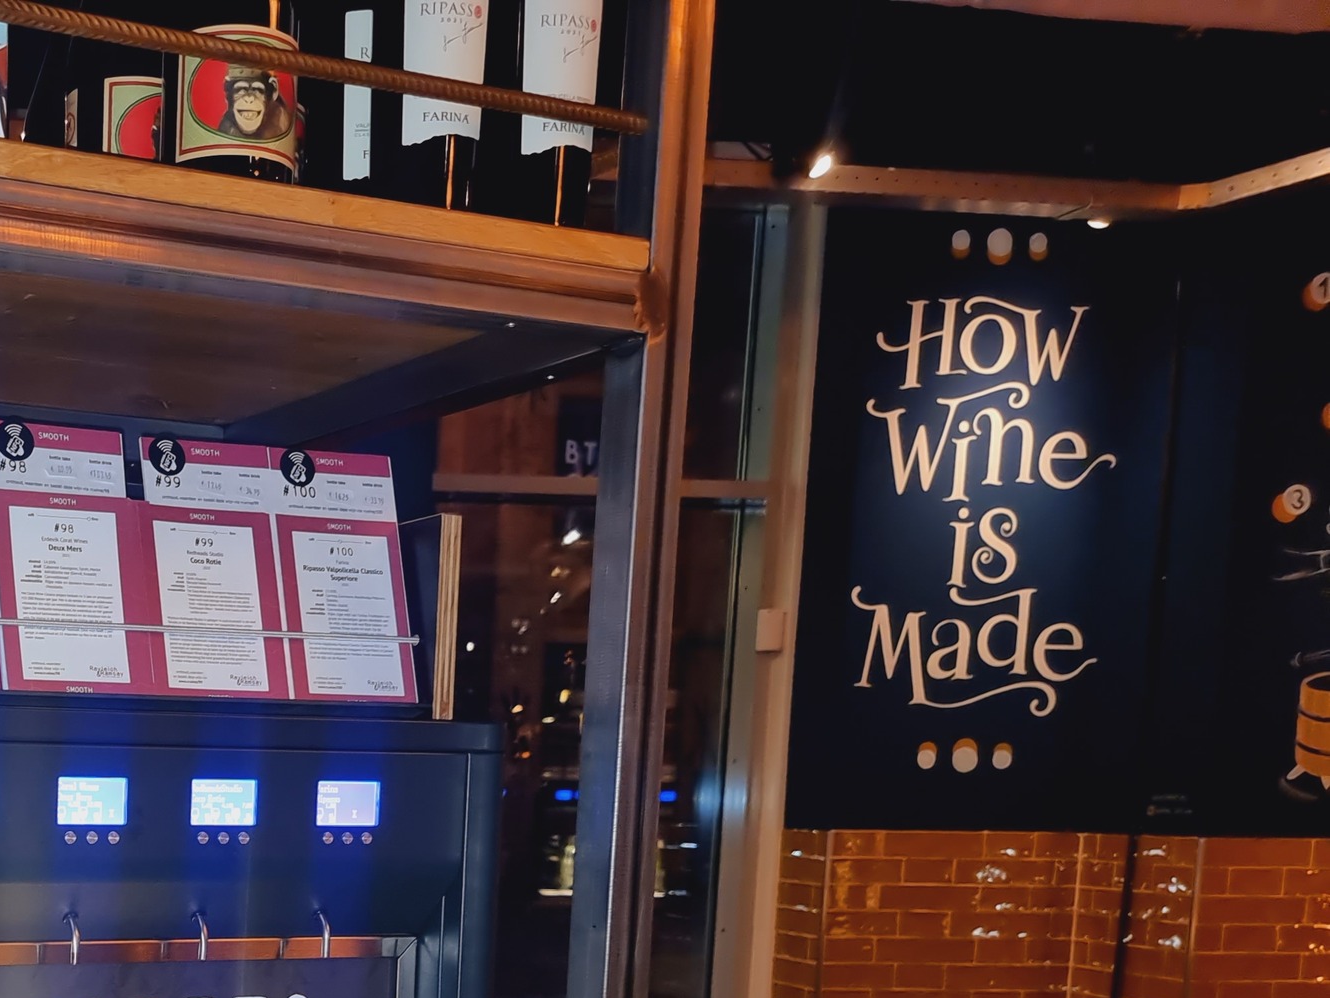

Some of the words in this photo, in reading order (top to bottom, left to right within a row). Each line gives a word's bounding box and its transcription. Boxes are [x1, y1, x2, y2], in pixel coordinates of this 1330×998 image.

[38, 431, 70, 441] SMOOTH
[866, 381, 1117, 503] Wine
[190, 447, 220, 456] SMOOTH
[0, 458, 27, 473] #98
[316, 458, 343, 466] SMOOTH
[155, 475, 181, 488] #99
[283, 484, 316, 498] #100
[49, 497, 76, 505] SMOOTH
[54, 523, 74, 534] #98
[48, 543, 65, 551] Deux
[195, 538, 213, 547] #99
[947, 506, 1019, 588] is
[330, 547, 353, 556] #100
[851, 585, 1098, 718] Made
[66, 686, 94, 694] SMOOTH
